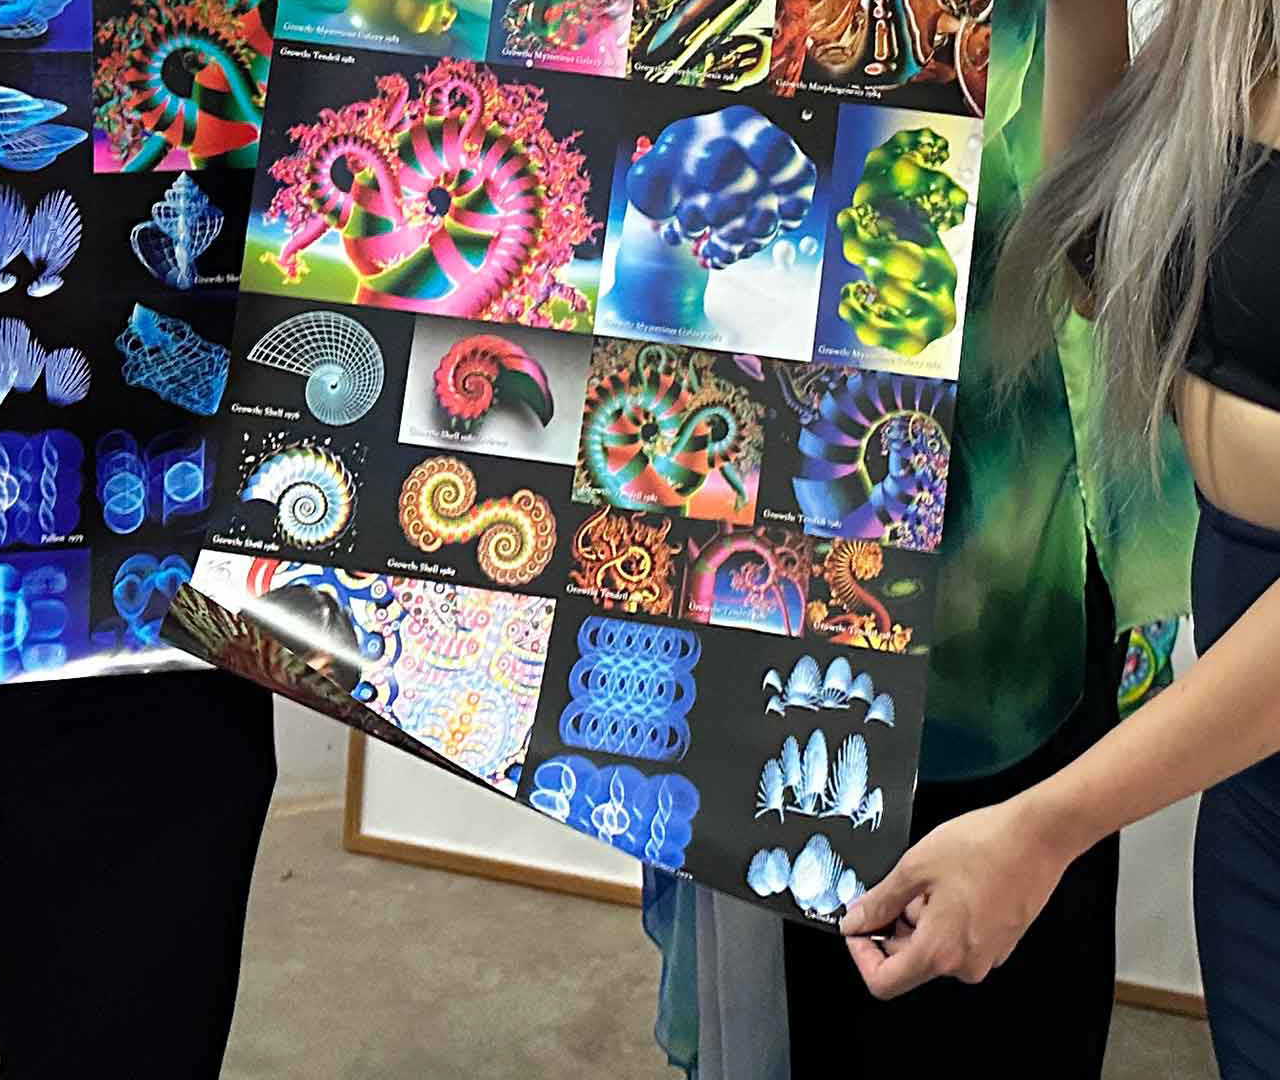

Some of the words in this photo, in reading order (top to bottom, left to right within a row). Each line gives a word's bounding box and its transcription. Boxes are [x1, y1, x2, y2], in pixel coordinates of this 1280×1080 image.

[312, 51, 340, 63] Tendril
[264, 406, 284, 417] Shell
[243, 537, 264, 549] Shell
[419, 562, 439, 575] Shell
